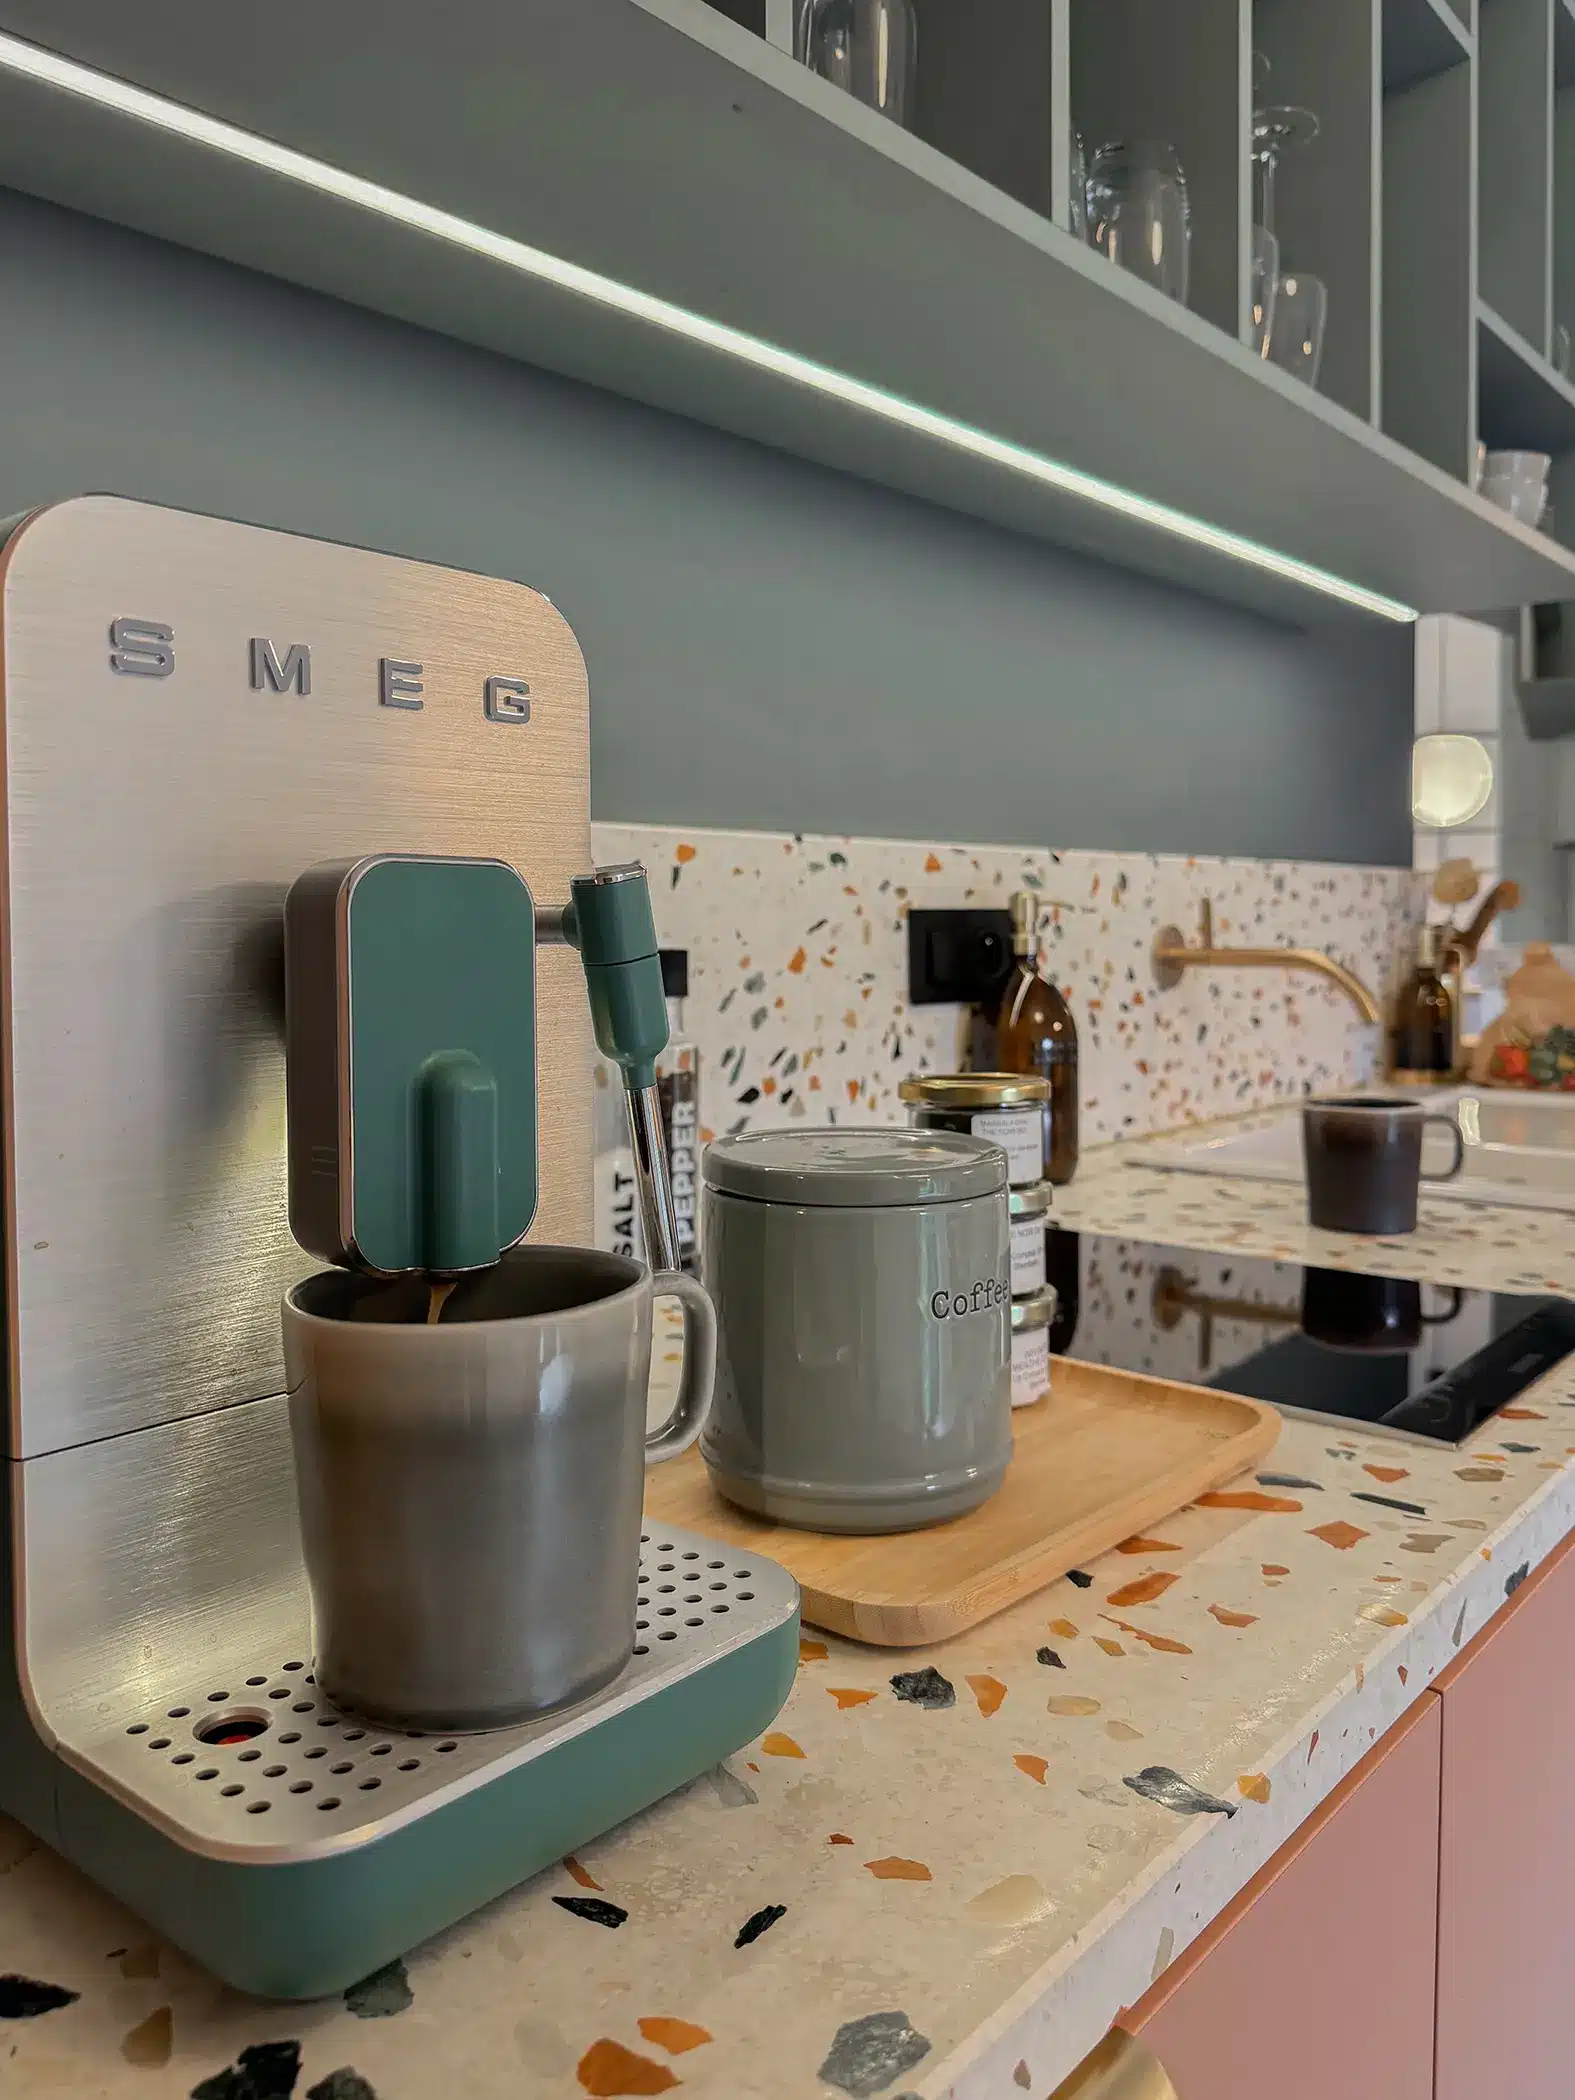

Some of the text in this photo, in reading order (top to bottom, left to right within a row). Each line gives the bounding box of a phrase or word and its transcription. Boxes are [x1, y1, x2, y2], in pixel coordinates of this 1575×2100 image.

[110, 616, 531, 724] SMEG
[671, 1101, 695, 1244] PEPPER
[931, 1277, 1008, 1319] Coffee
